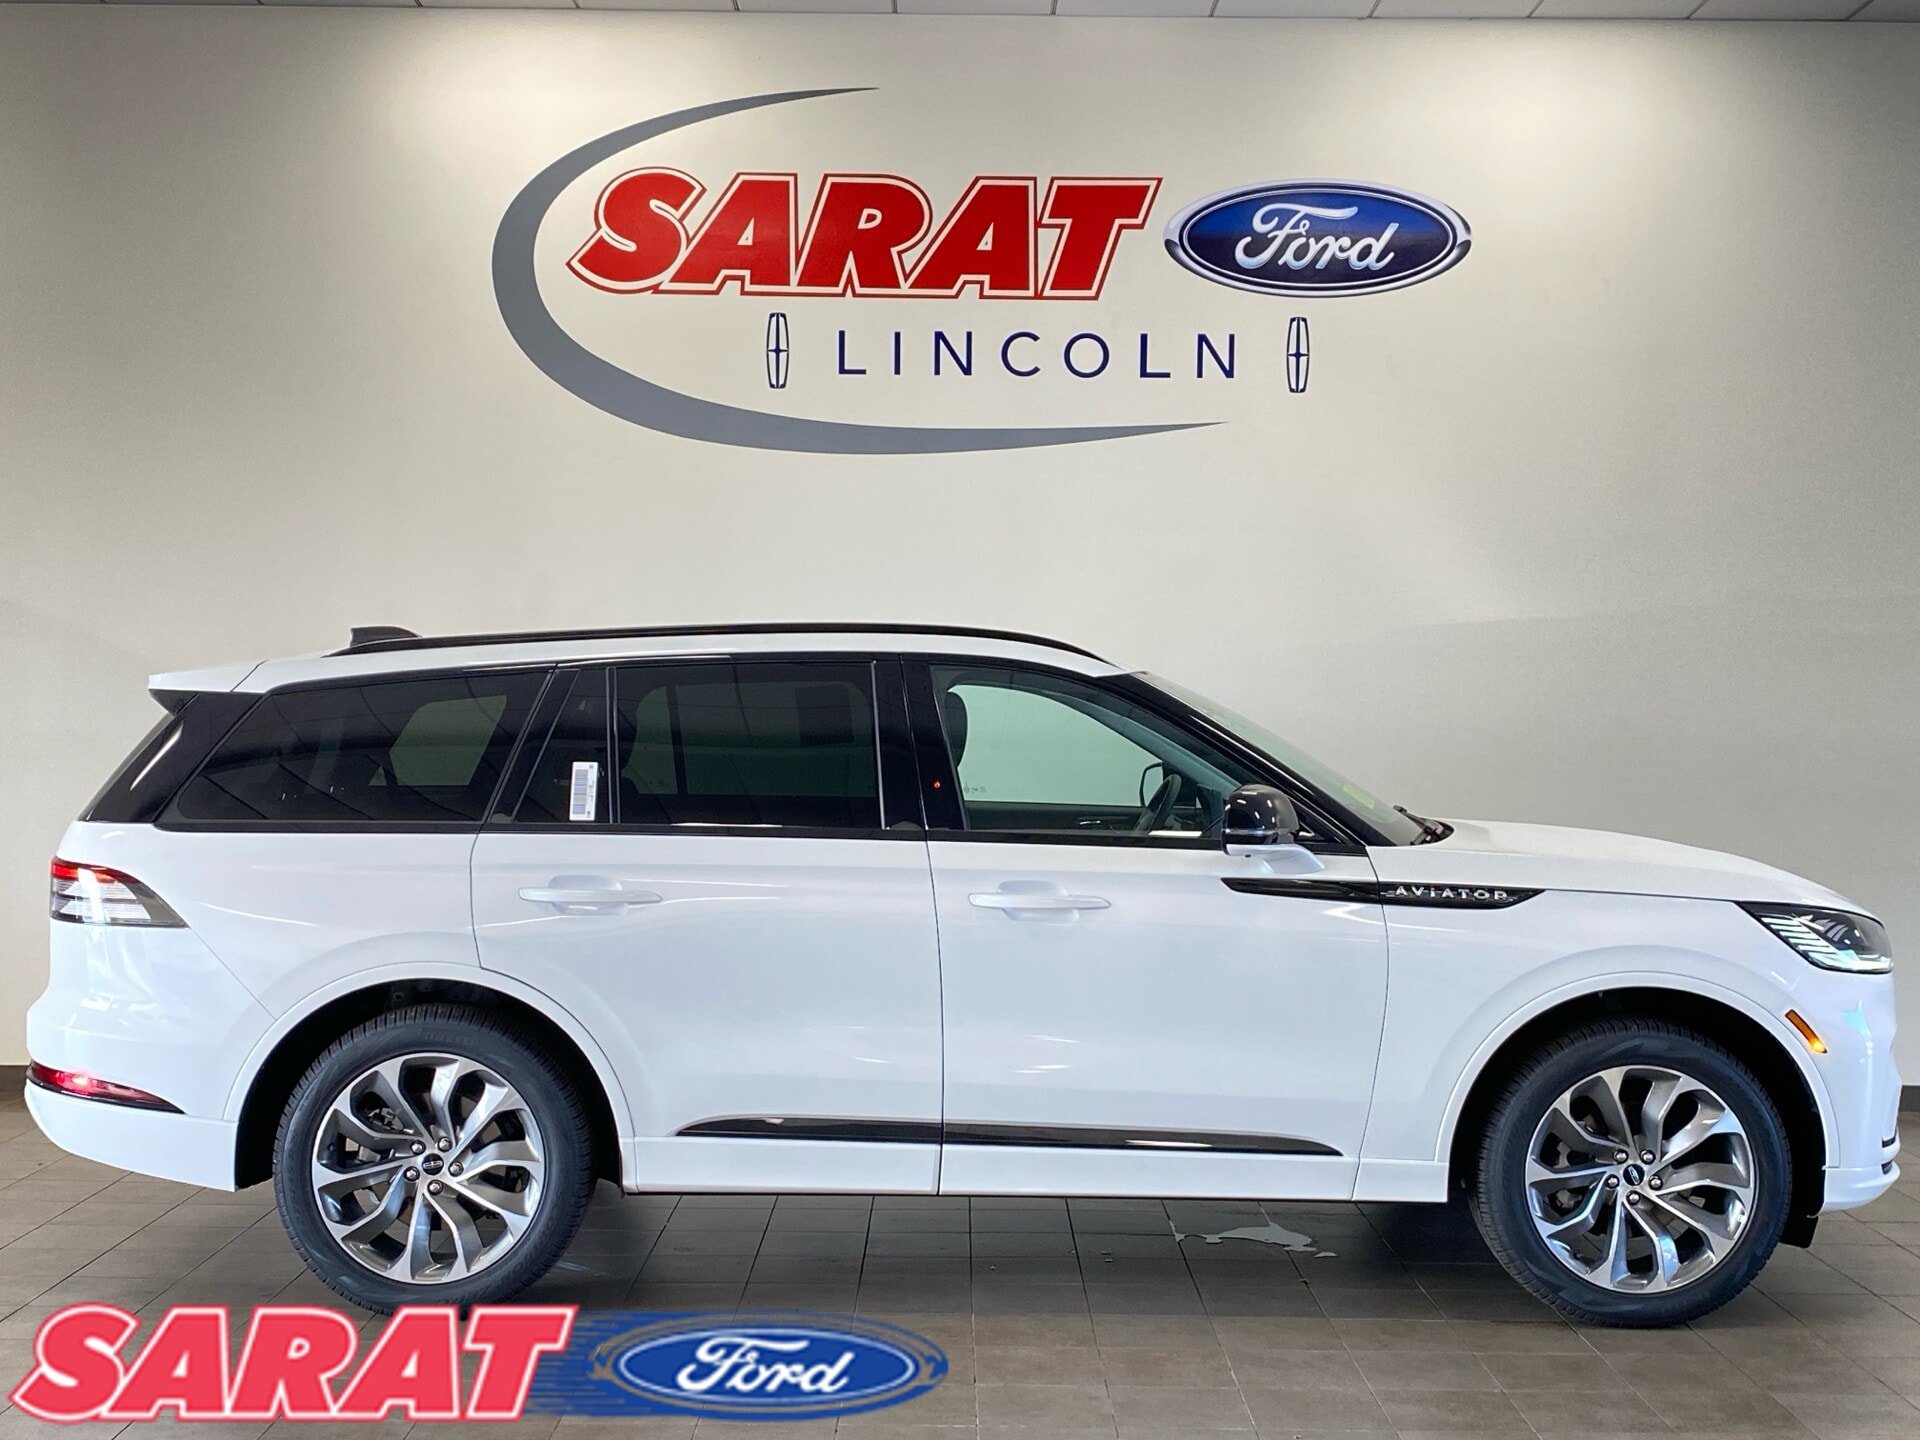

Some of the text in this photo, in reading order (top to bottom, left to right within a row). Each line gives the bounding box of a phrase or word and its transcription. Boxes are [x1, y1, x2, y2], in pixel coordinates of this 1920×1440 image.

[566, 168, 1161, 300] SARAT
[1235, 204, 1398, 272] Ford
[837, 331, 1236, 379] LINCOLN
[1394, 885, 1510, 901] AVIATOR
